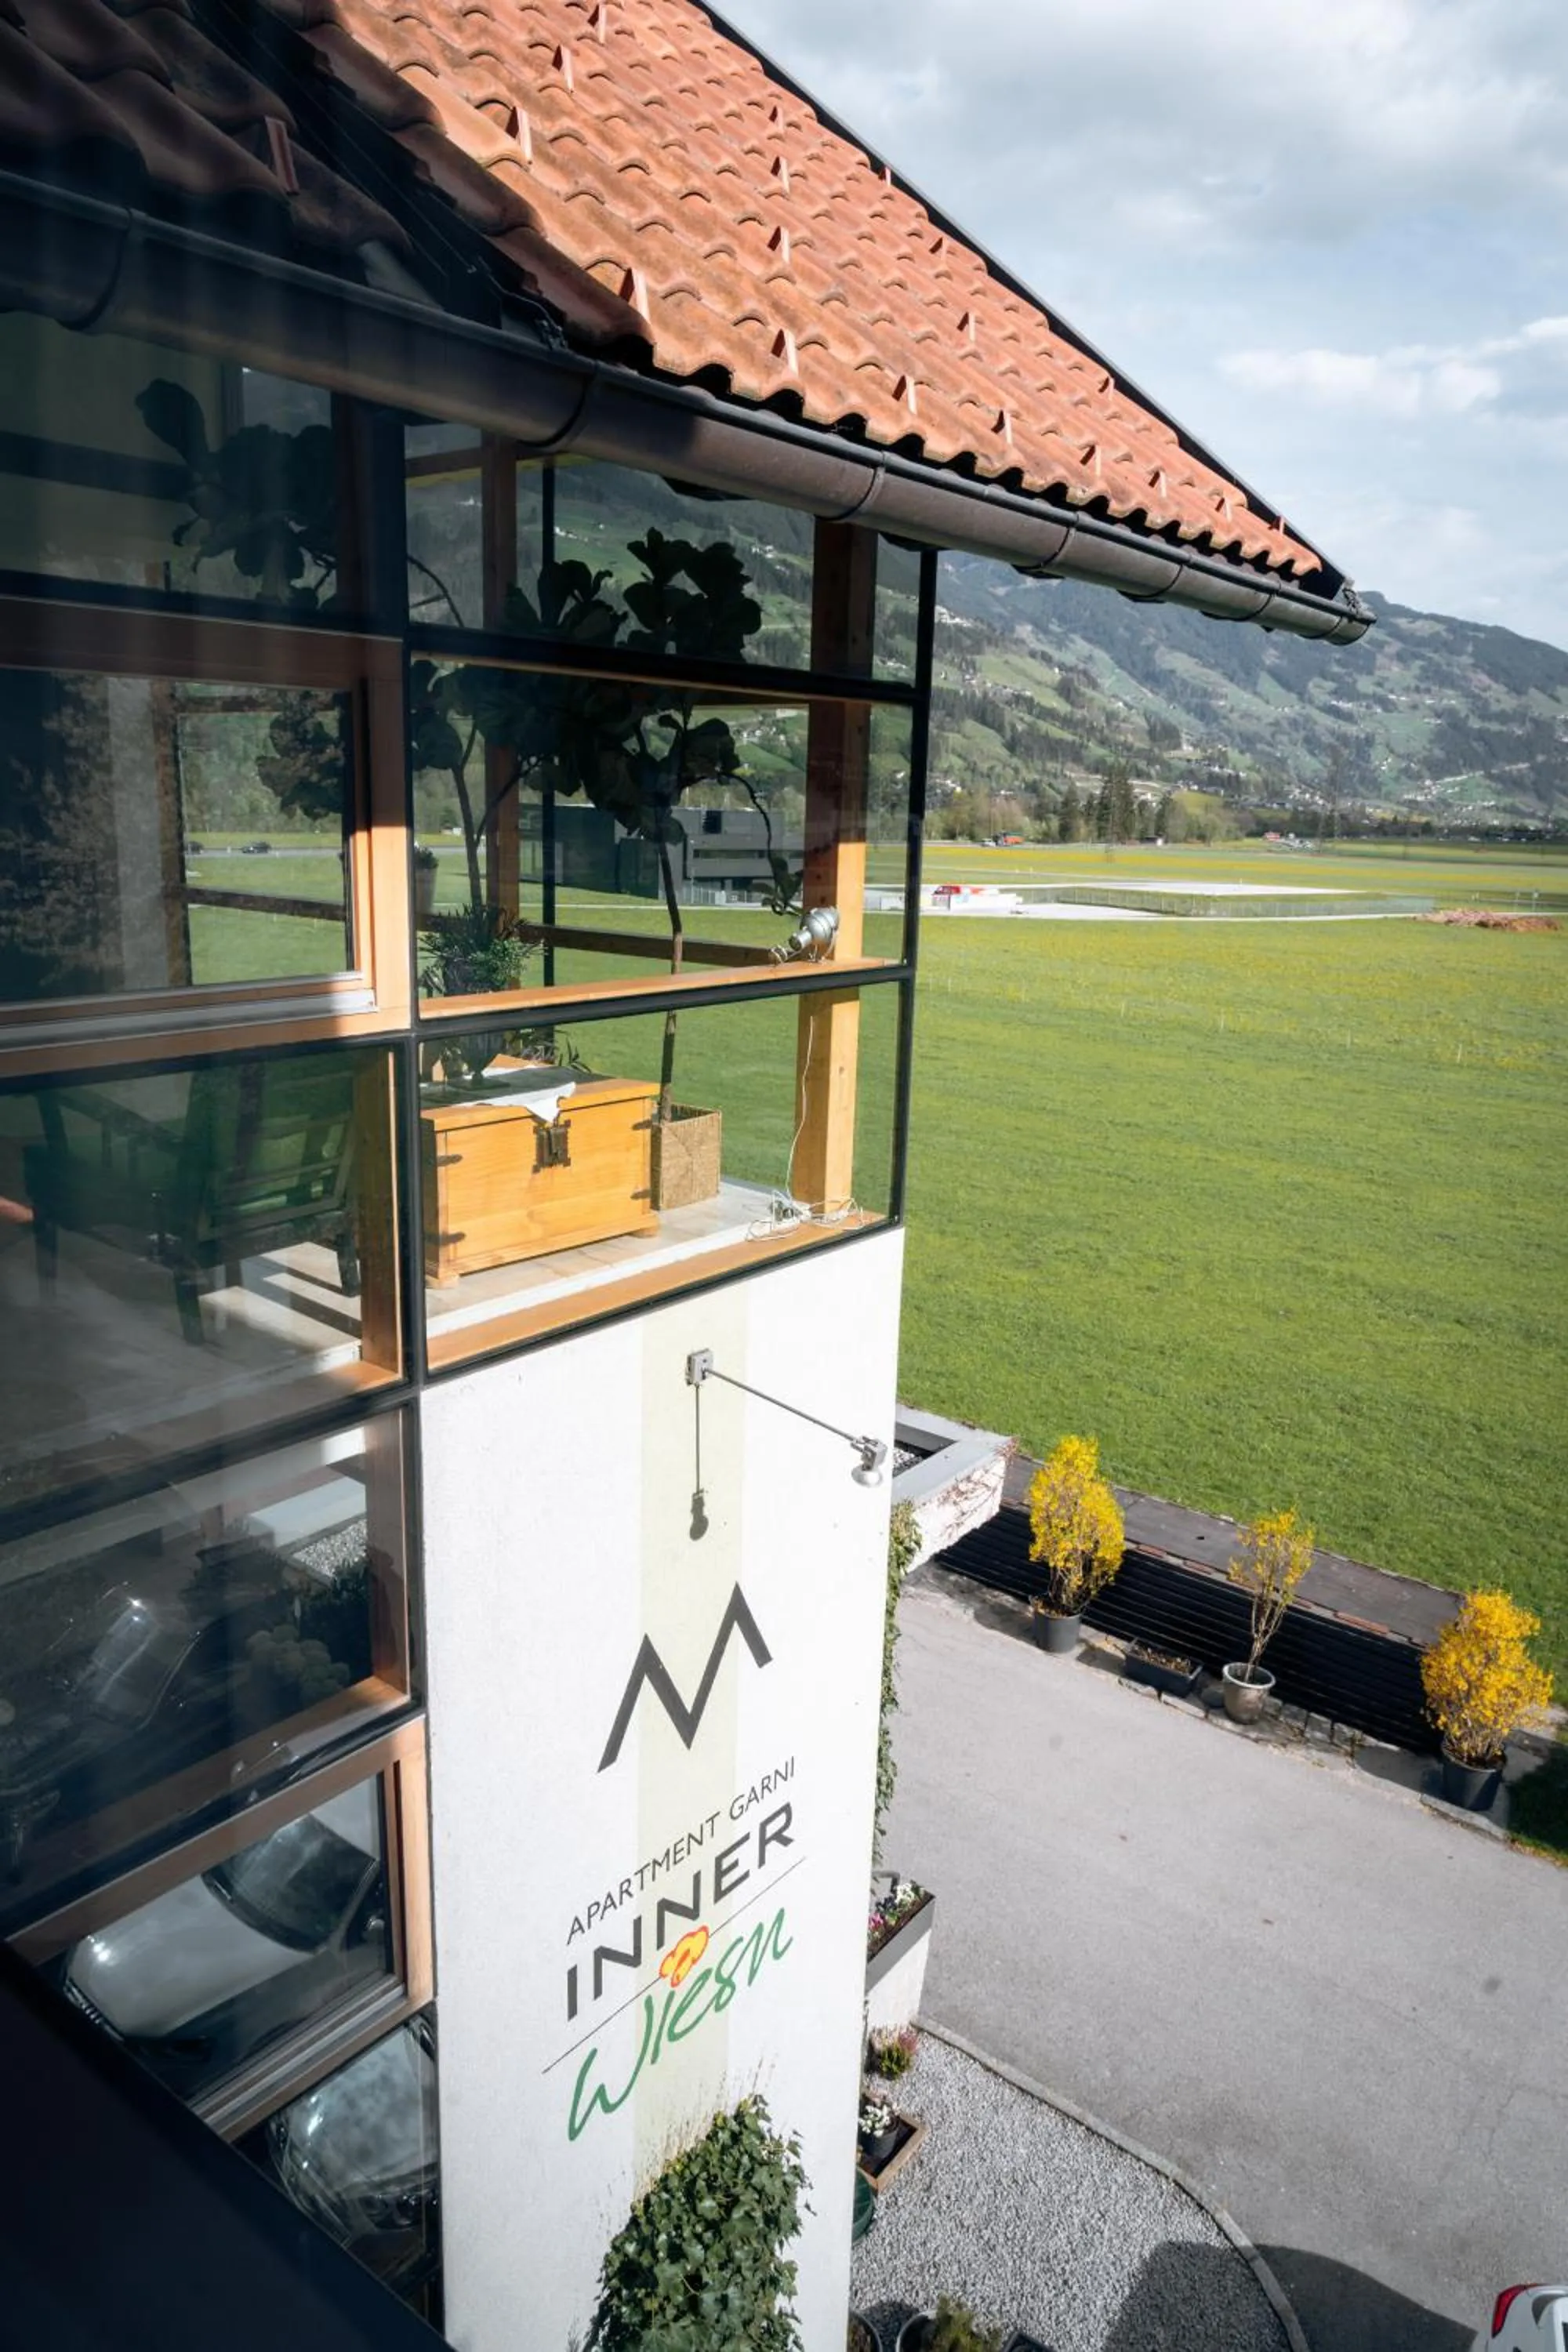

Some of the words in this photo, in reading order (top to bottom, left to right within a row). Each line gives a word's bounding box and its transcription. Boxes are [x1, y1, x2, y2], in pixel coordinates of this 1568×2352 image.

[566, 1811, 720, 1946] APARTMENT
[729, 1756, 795, 1820] GARNI
[567, 1802, 794, 2021] INNER
